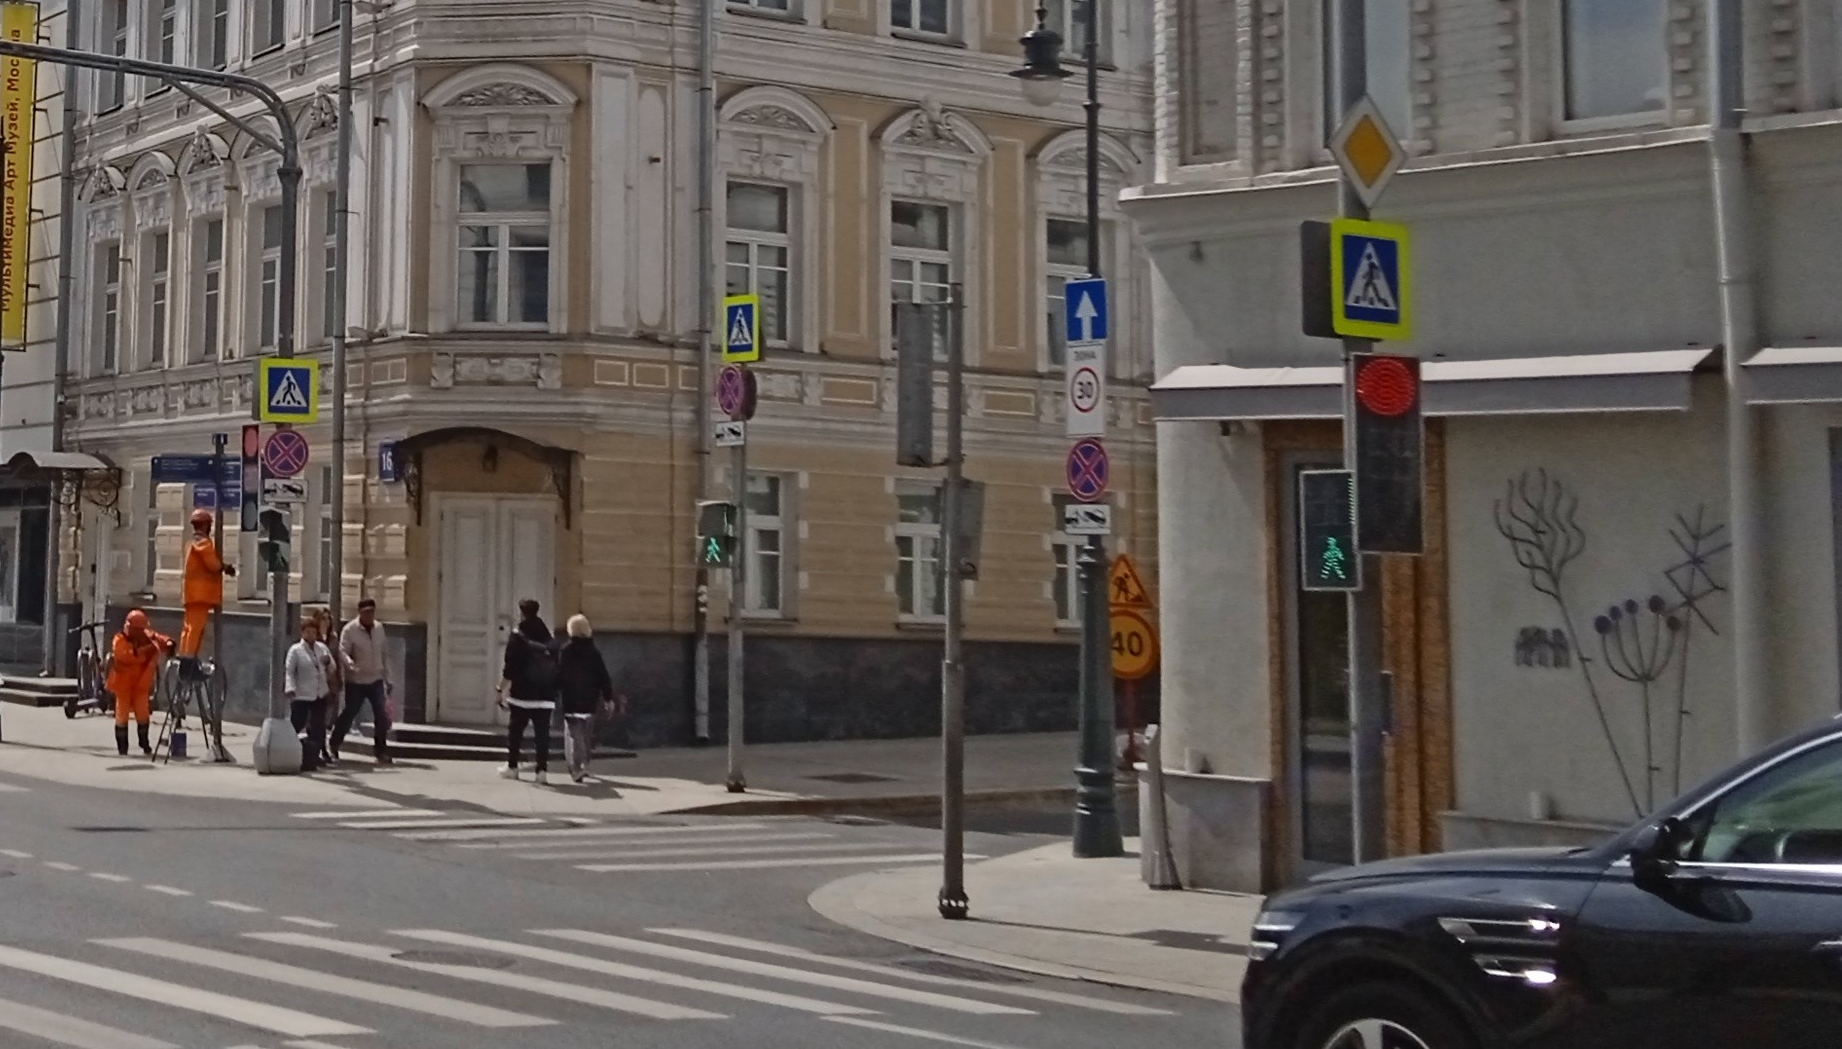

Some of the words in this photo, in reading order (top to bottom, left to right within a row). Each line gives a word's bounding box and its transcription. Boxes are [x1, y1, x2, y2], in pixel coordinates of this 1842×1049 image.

[7, 29, 21, 92] Моса
[4, 157, 18, 191] Арт
[1077, 381, 1094, 399] 30
[382, 451, 393, 471] 16
[1111, 631, 1143, 658] 40
